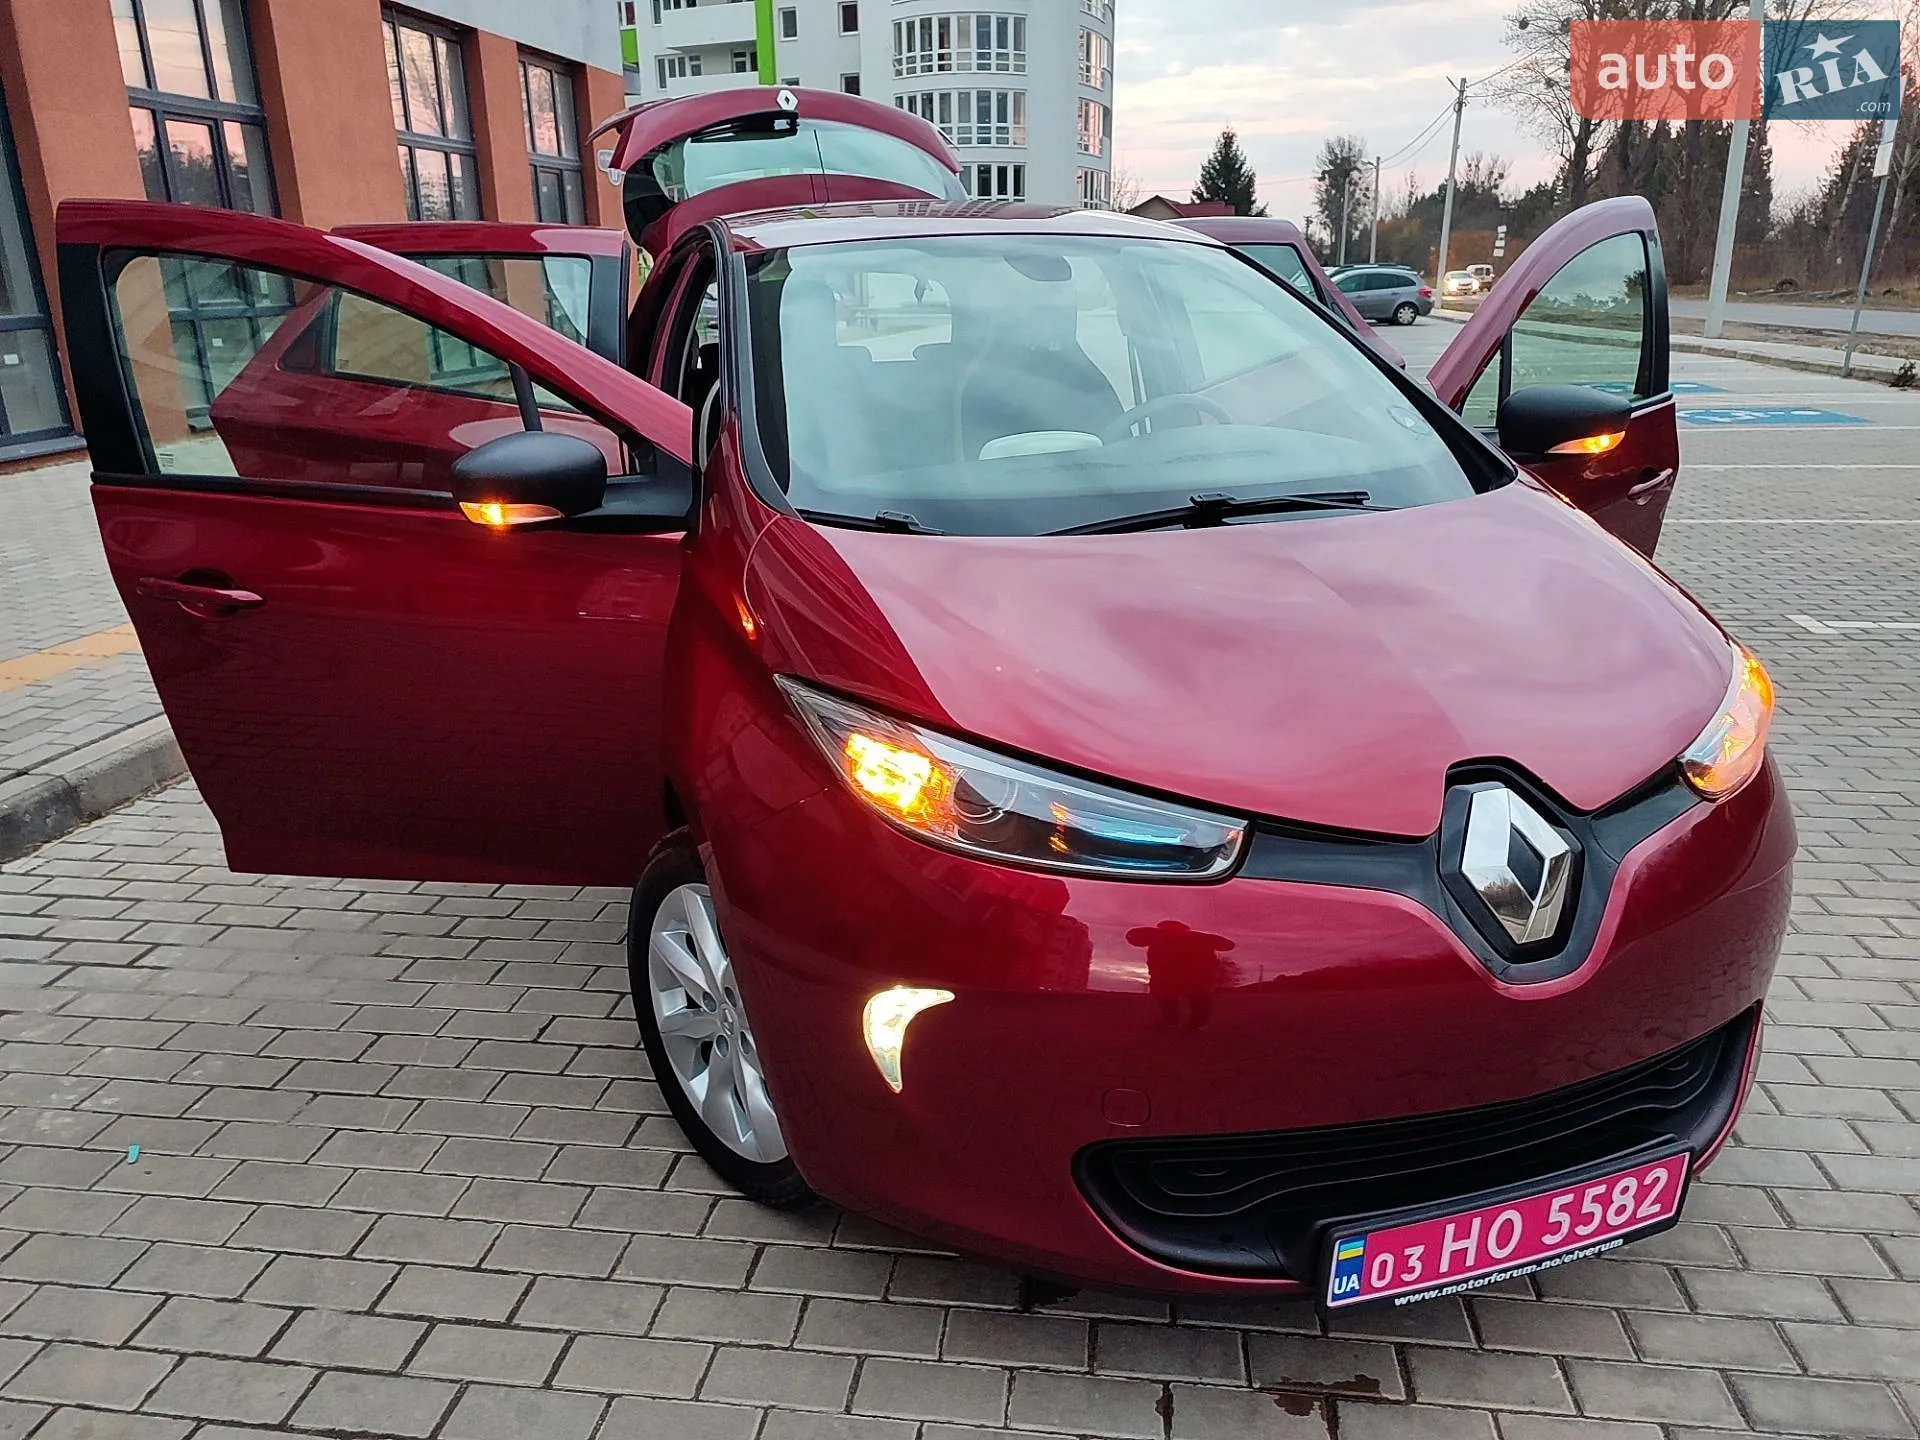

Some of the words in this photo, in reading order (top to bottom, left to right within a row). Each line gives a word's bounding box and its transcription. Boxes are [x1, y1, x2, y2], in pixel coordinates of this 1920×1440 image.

[1370, 1244, 1422, 1288] 03
[1438, 1210, 1523, 1274] HO
[1541, 1167, 1668, 1246] 5582
[1333, 1273, 1360, 1295] UA
[1394, 1238, 1624, 1307] www.motorforum.no/elverum
